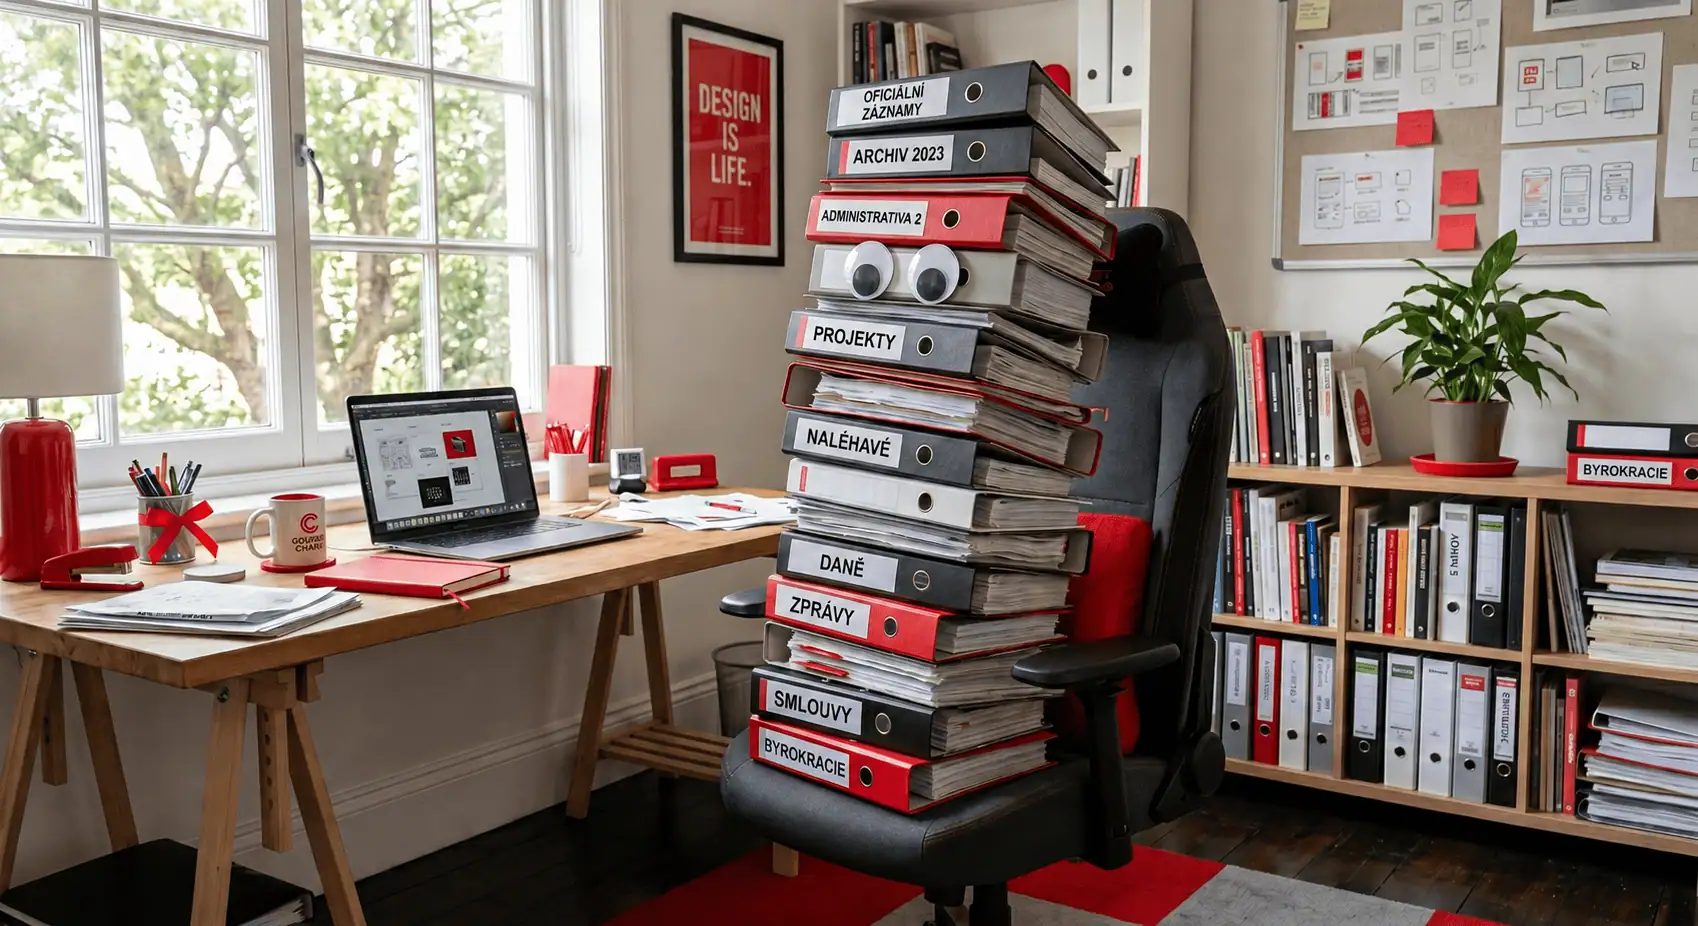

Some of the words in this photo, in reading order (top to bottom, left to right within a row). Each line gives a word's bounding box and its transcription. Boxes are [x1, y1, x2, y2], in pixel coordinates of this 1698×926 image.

[699, 83, 761, 123] DESIGN
[863, 81, 925, 103] OFICIÁLNÍ
[861, 101, 924, 121] ZÁZNAMY
[722, 121, 739, 152] IS
[853, 147, 909, 164] ARCHIV
[911, 145, 945, 162] 2023
[711, 153, 751, 187] LIFE.
[821, 209, 912, 225] ADMINISTRATIVA
[914, 212, 922, 225] 2
[812, 325, 897, 351] PROJEKTY
[806, 428, 891, 458] NALÉHAVÉ
[1583, 463, 1668, 480] BYROKRACIE
[819, 554, 865, 578] DANĚ
[789, 596, 855, 626] ZPRÁVY
[773, 690, 853, 724] SMLOUVY
[764, 737, 846, 778] BYROKRACIE
